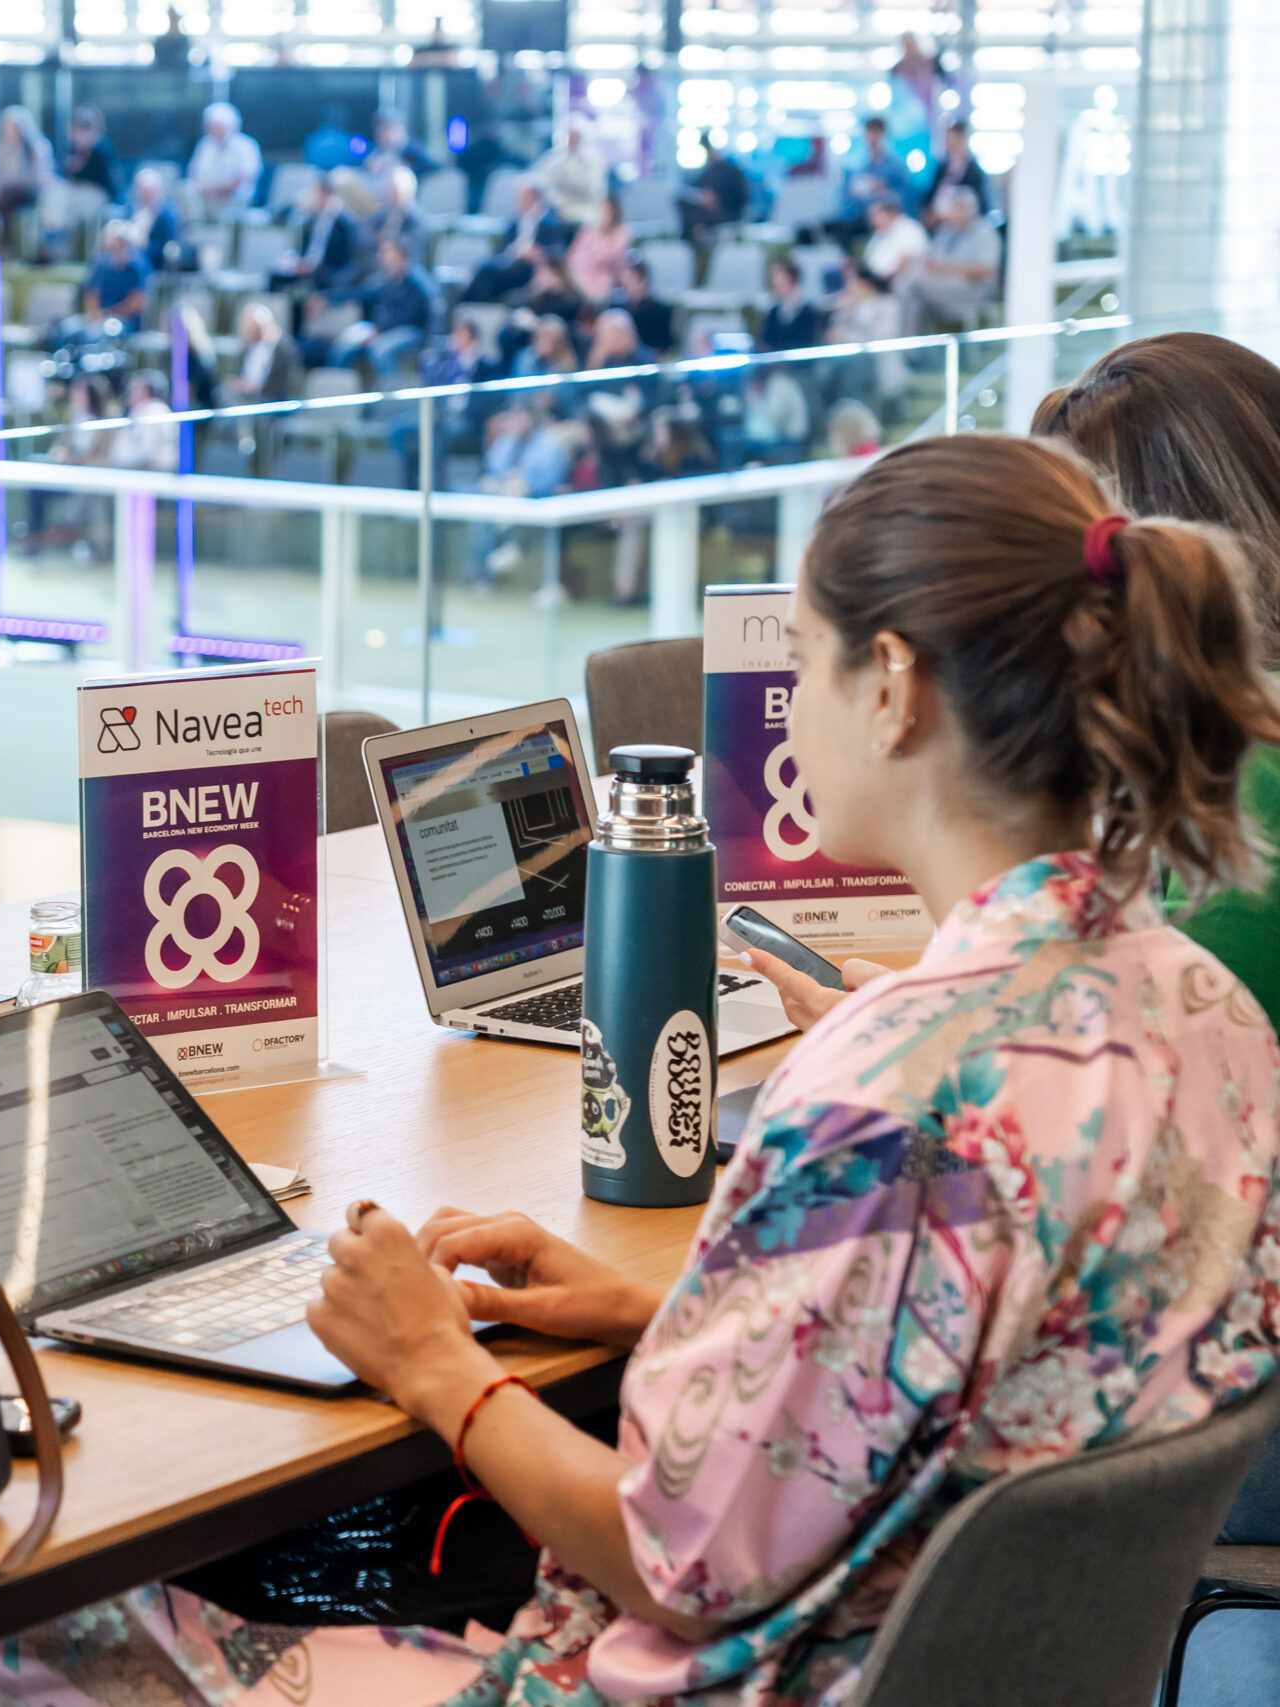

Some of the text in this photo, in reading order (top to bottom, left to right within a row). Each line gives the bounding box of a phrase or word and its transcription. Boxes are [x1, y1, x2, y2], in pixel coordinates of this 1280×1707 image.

[156, 695, 303, 745] Navea tech
[142, 782, 259, 828] BNEW
[143, 829, 186, 839] BARCELONA
[187, 826, 203, 835] NEW
[204, 824, 239, 833] ECONOMY
[724, 875, 912, 892] CONECTAR IMPULSAR TRANSFORMA
[804, 909, 922, 922] BNEW DFACTORY
[128, 996, 297, 1025] ECTAR IMPULSAR TRANSFORMAR
[189, 1043, 223, 1057] BNEW
[264, 1034, 305, 1046] DFACTORY
